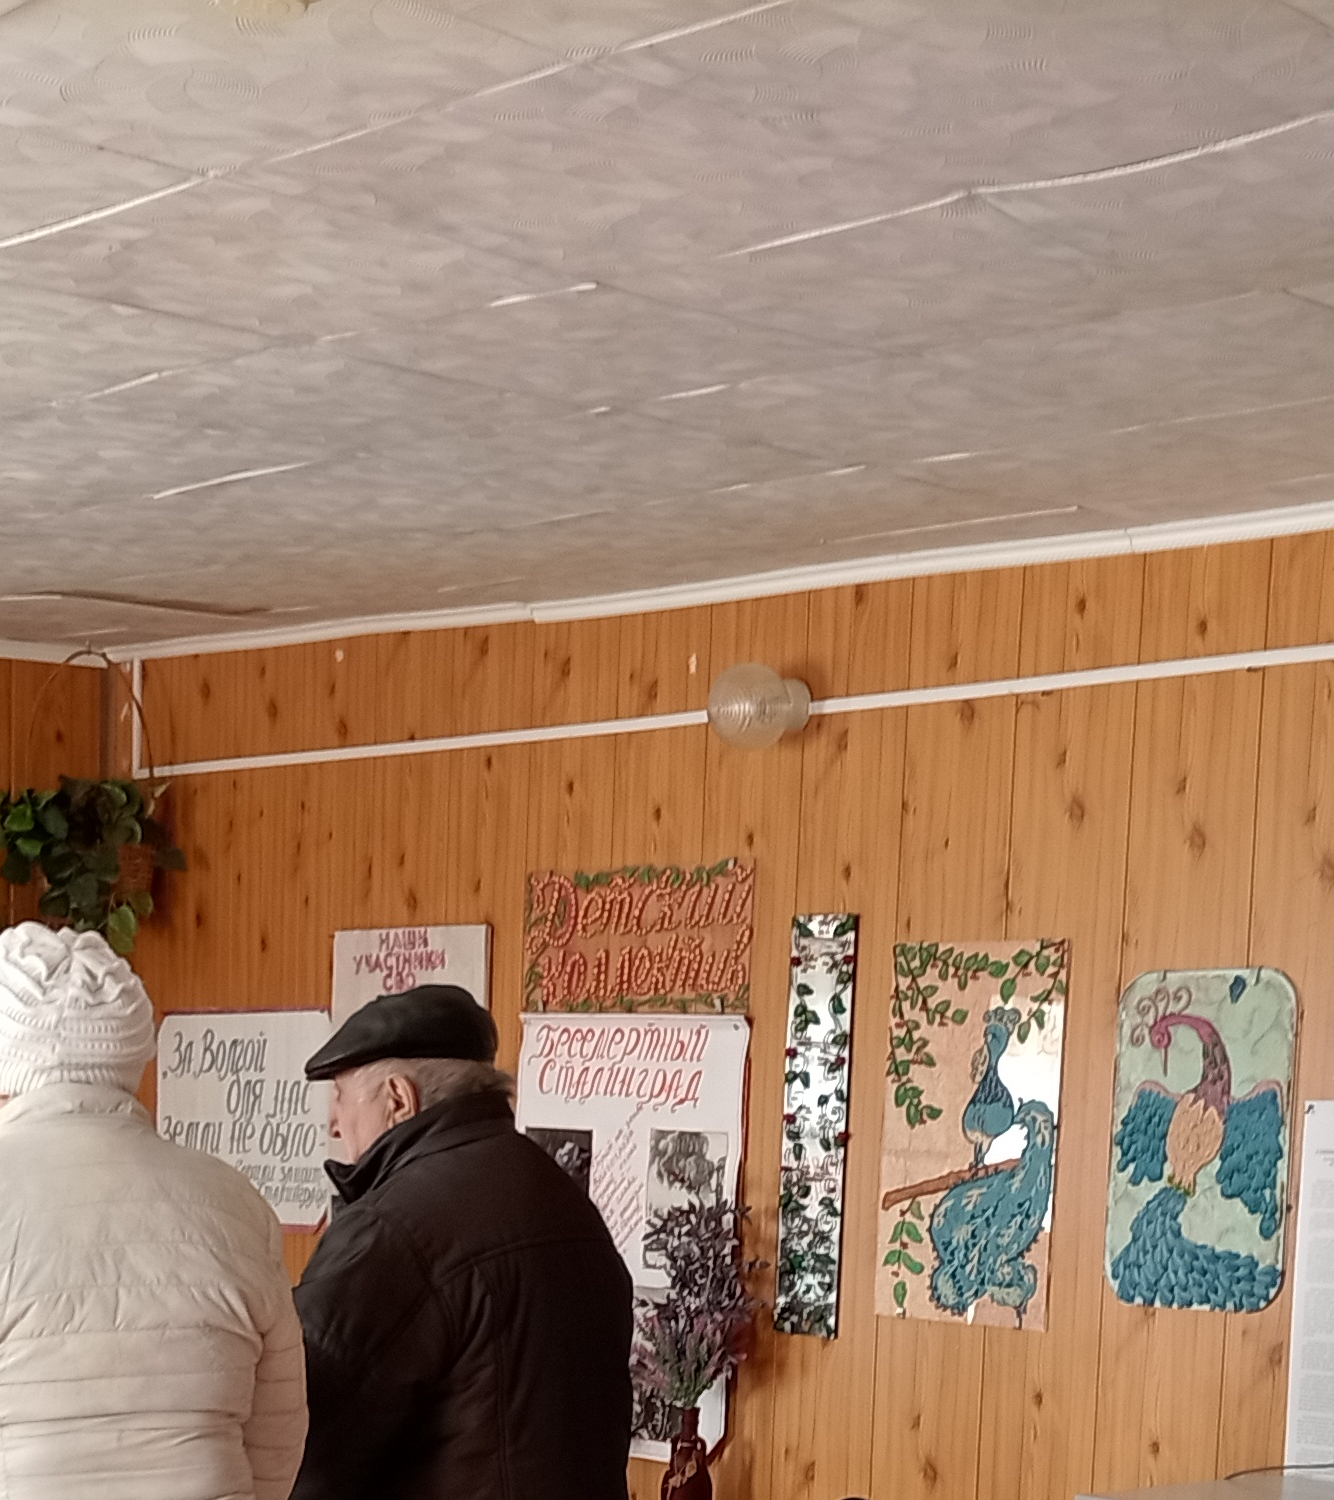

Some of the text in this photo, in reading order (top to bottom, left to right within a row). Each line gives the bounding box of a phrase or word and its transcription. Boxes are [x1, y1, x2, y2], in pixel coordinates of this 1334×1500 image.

[378, 928, 430, 952] НАШИ
[353, 949, 446, 976] УЧАСТНИКИ
[194, 1028, 268, 1082] Волгой
[225, 1072, 267, 1123] для
[229, 1119, 257, 1155] не
